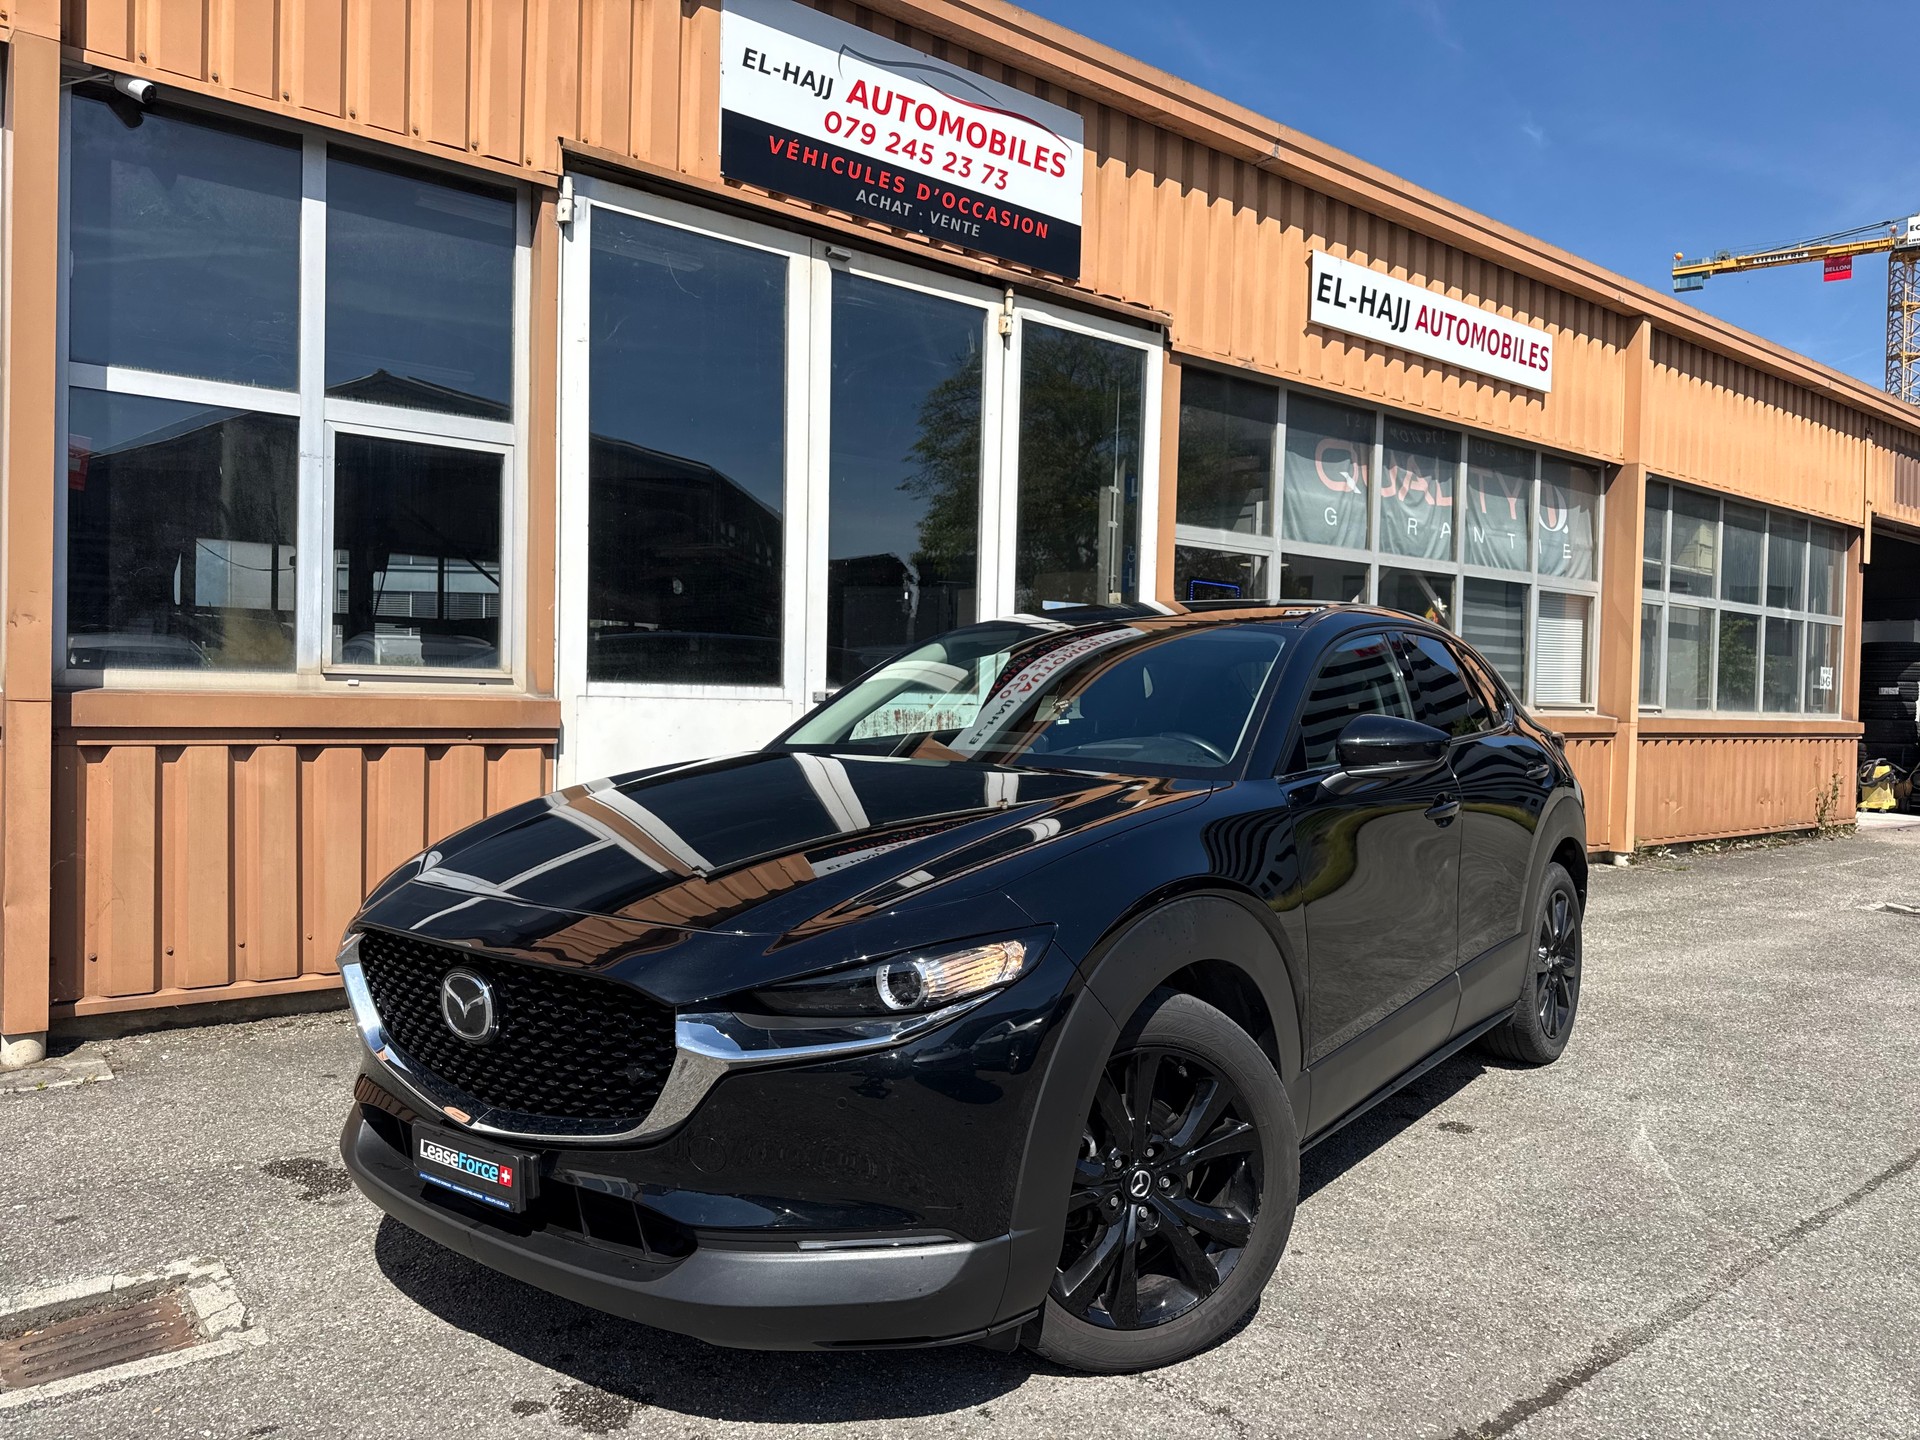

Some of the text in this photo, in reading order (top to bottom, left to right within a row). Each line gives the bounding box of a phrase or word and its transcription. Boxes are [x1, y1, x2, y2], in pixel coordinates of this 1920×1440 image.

[742, 47, 1067, 178] EL-HAJJ AUTOMOBILES
[824, 110, 1009, 191] 079 245 23 73
[768, 130, 1049, 239] VÉHICULES D'OCCASION
[855, 189, 981, 238] ACHAT VENTE
[1825, 264, 1851, 274] BELLONI
[1316, 271, 1550, 372] EL-HAJJ AUTOMOBILES
[1314, 438, 1528, 521] QUALTY
[419, 1138, 499, 1181] LeaseForce
